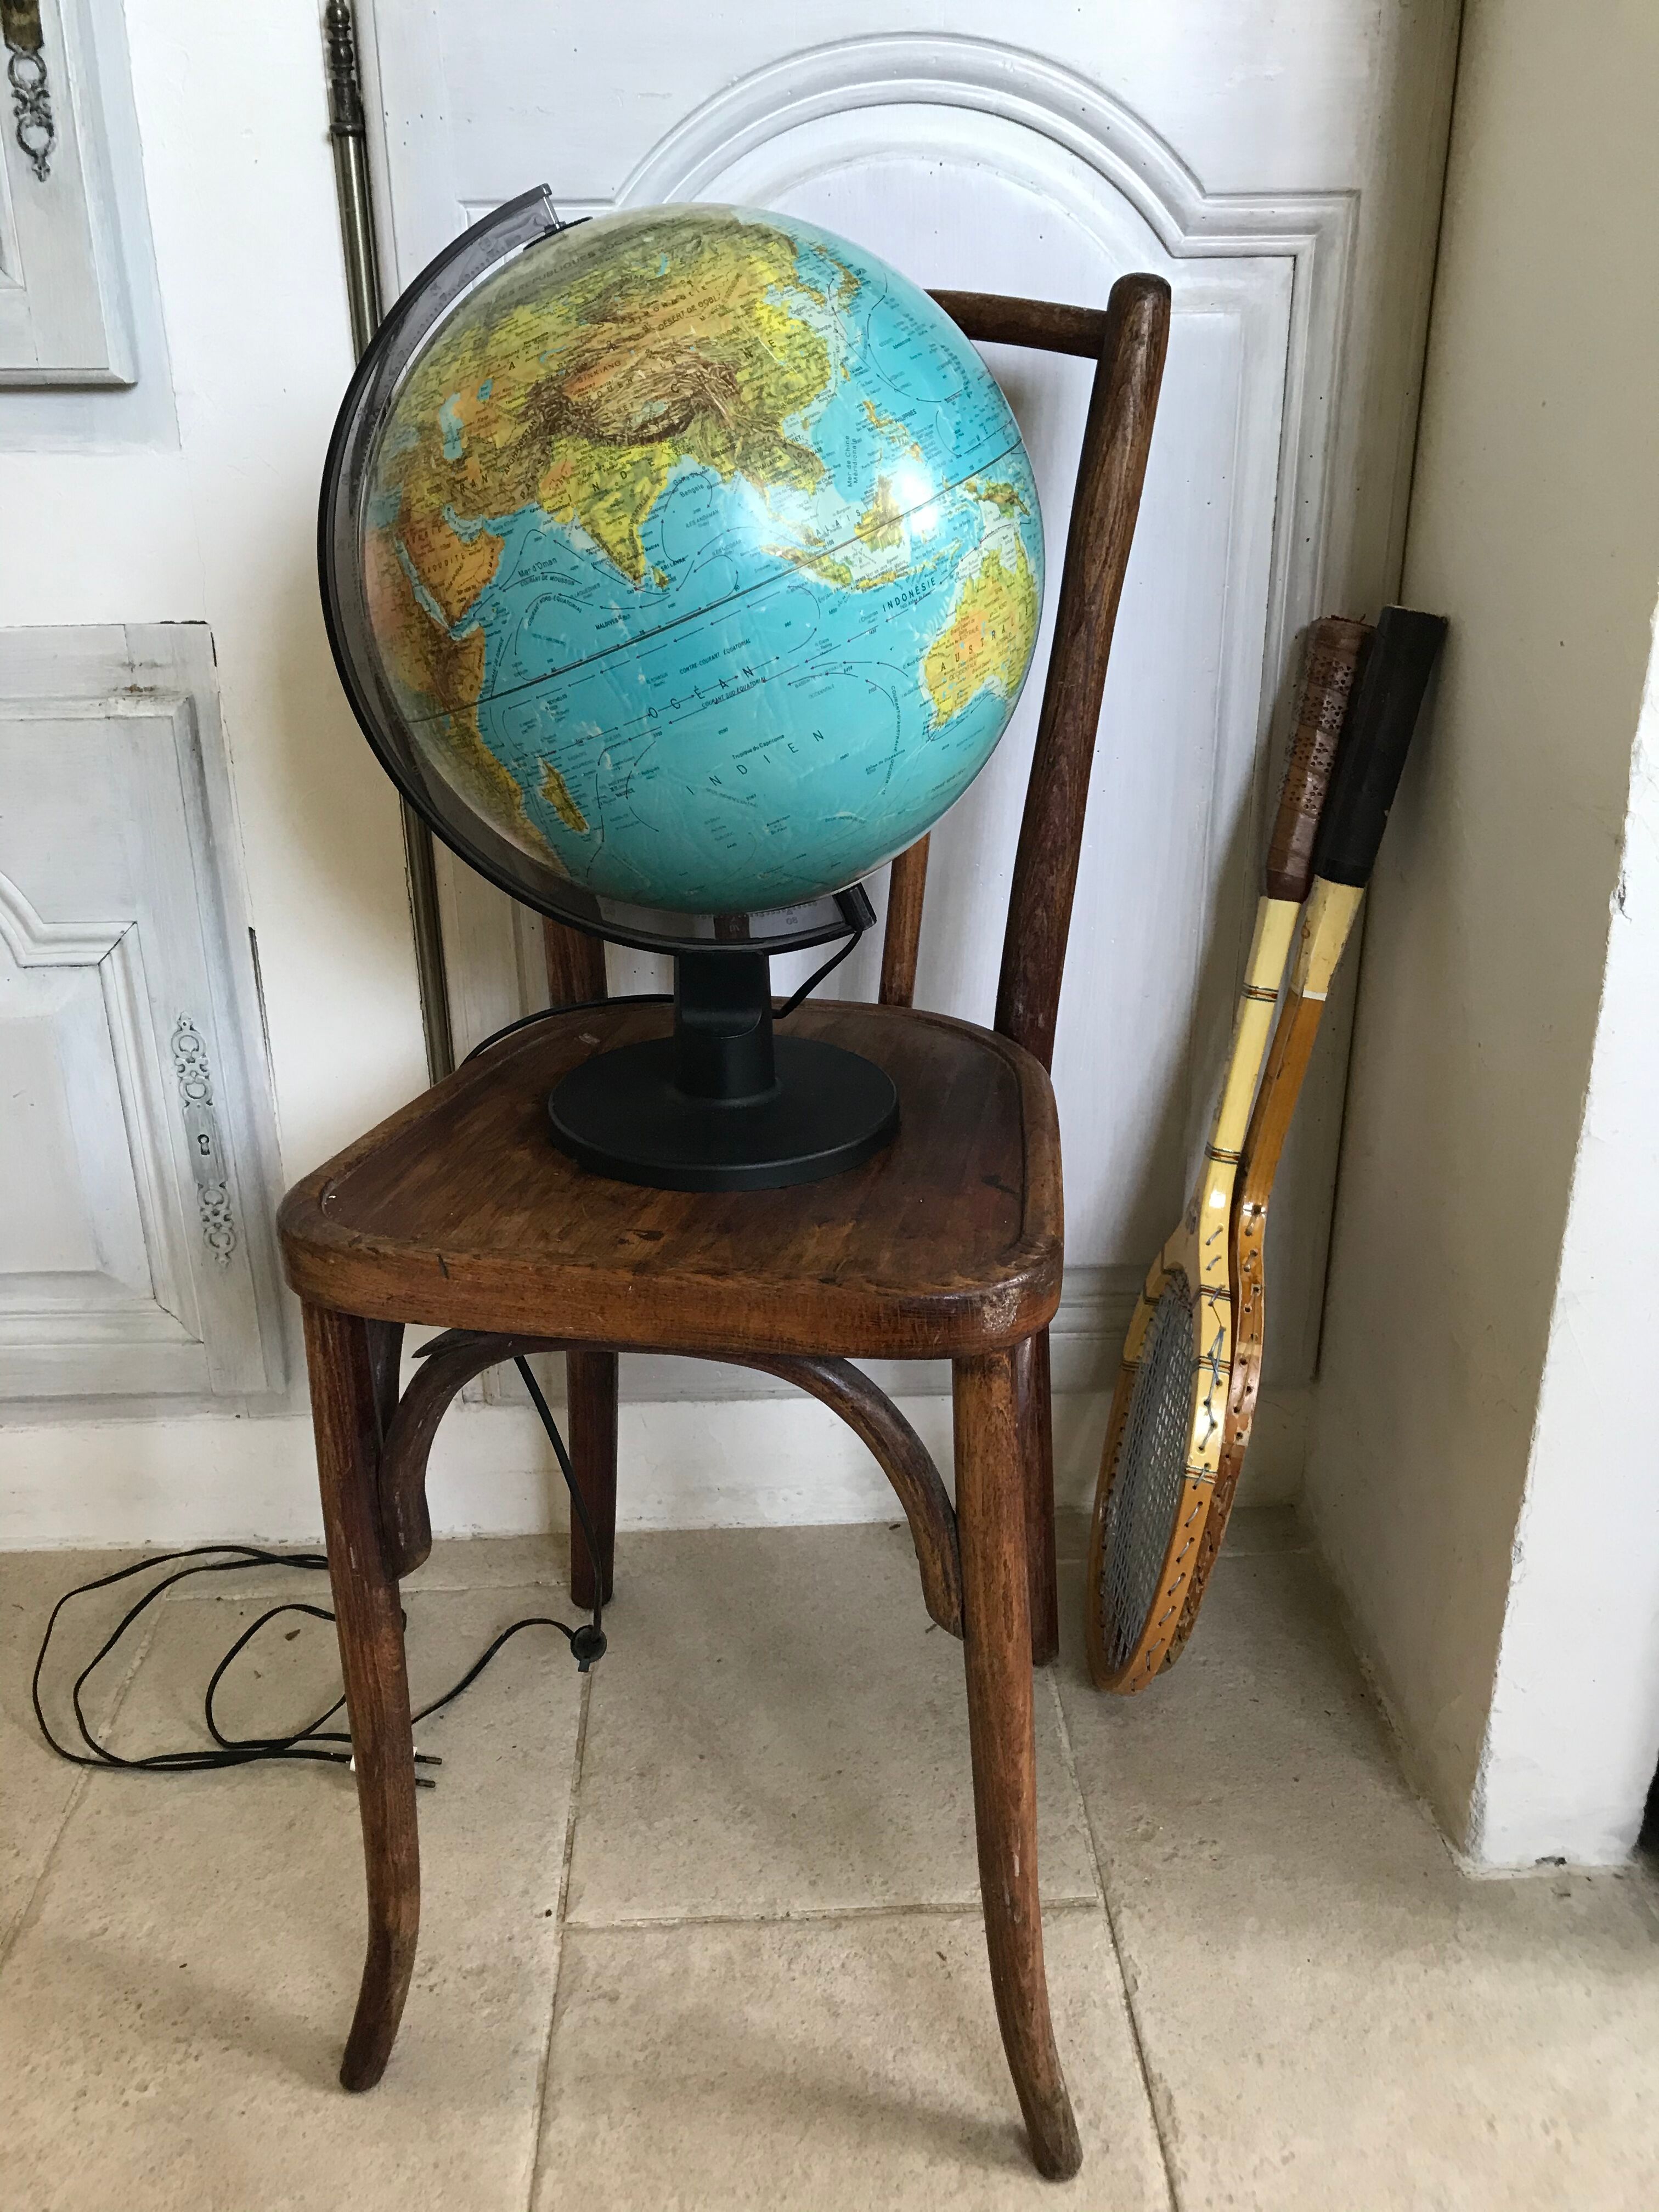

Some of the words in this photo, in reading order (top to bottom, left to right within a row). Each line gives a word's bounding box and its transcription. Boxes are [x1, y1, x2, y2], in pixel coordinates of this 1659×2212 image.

[882, 576, 936, 613] INDONÉSIE
[647, 665, 754, 719] OCÉAN
[686, 730, 825, 795] INDIEN
